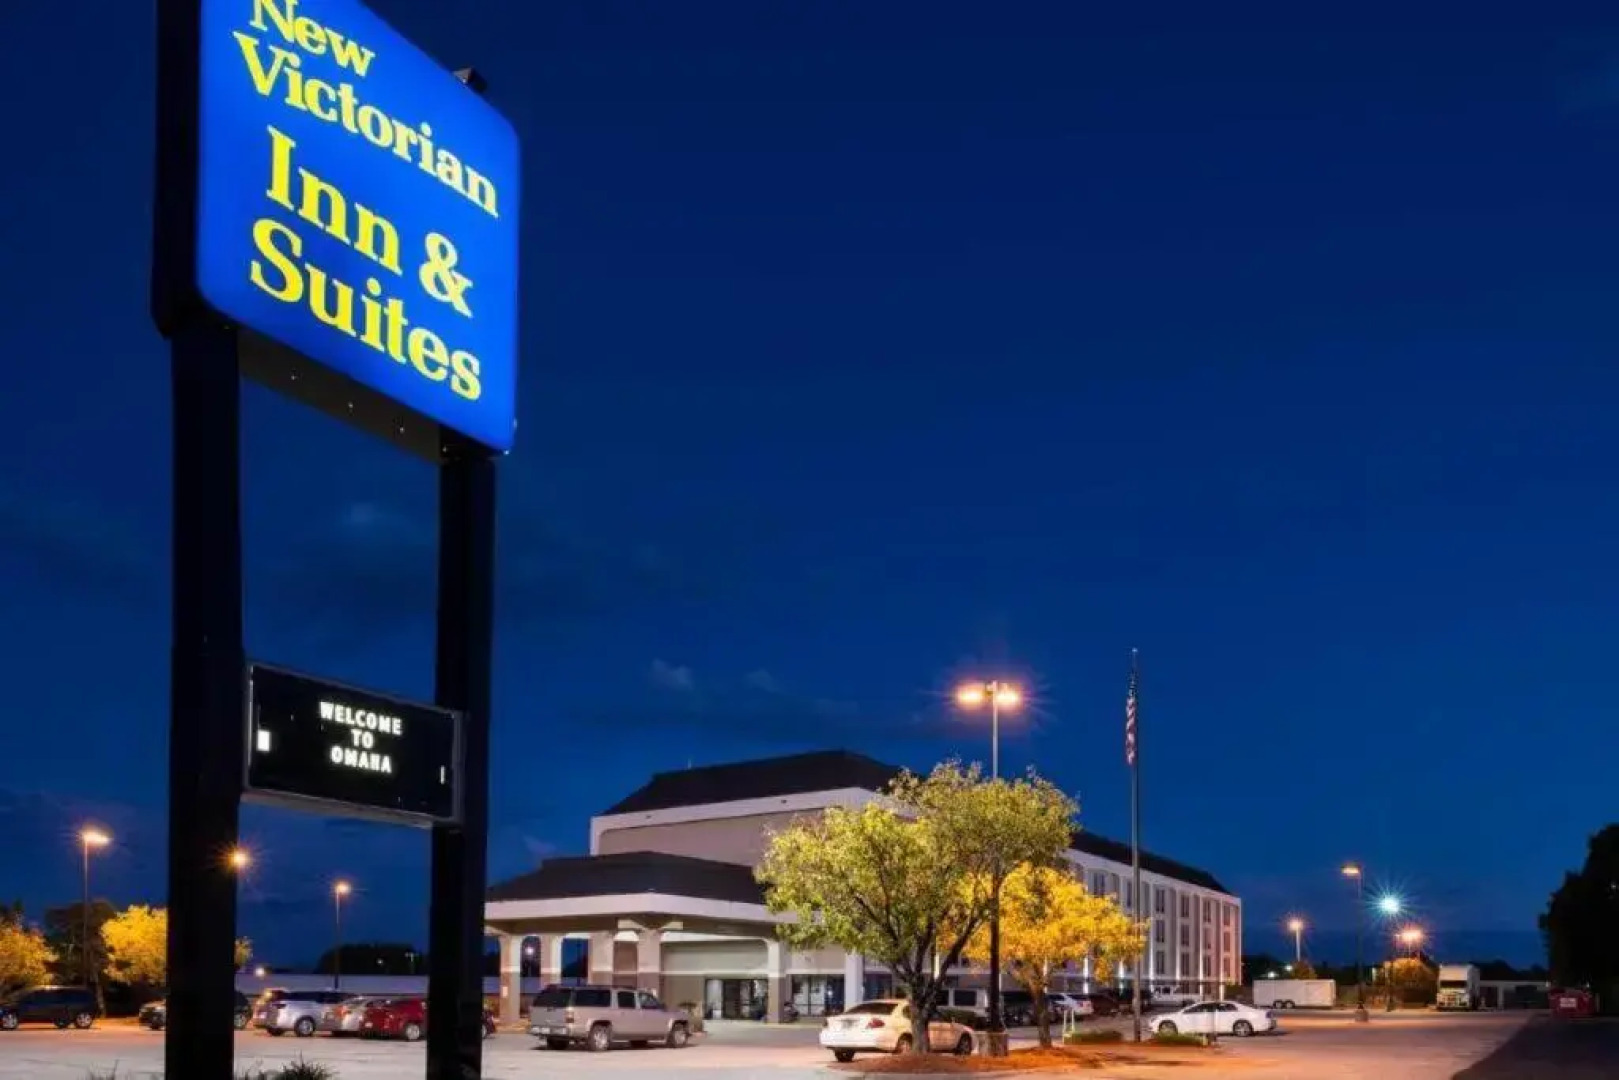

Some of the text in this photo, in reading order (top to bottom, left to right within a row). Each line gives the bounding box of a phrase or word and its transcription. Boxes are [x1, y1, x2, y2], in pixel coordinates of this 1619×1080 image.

[248, 0, 376, 78] New
[232, 31, 500, 219] Victorian
[266, 124, 474, 319] Inn &
[249, 218, 482, 401] Suites
[319, 701, 403, 736] WELCOME
[350, 727, 375, 750] TO
[329, 745, 393, 774] OMAHA
